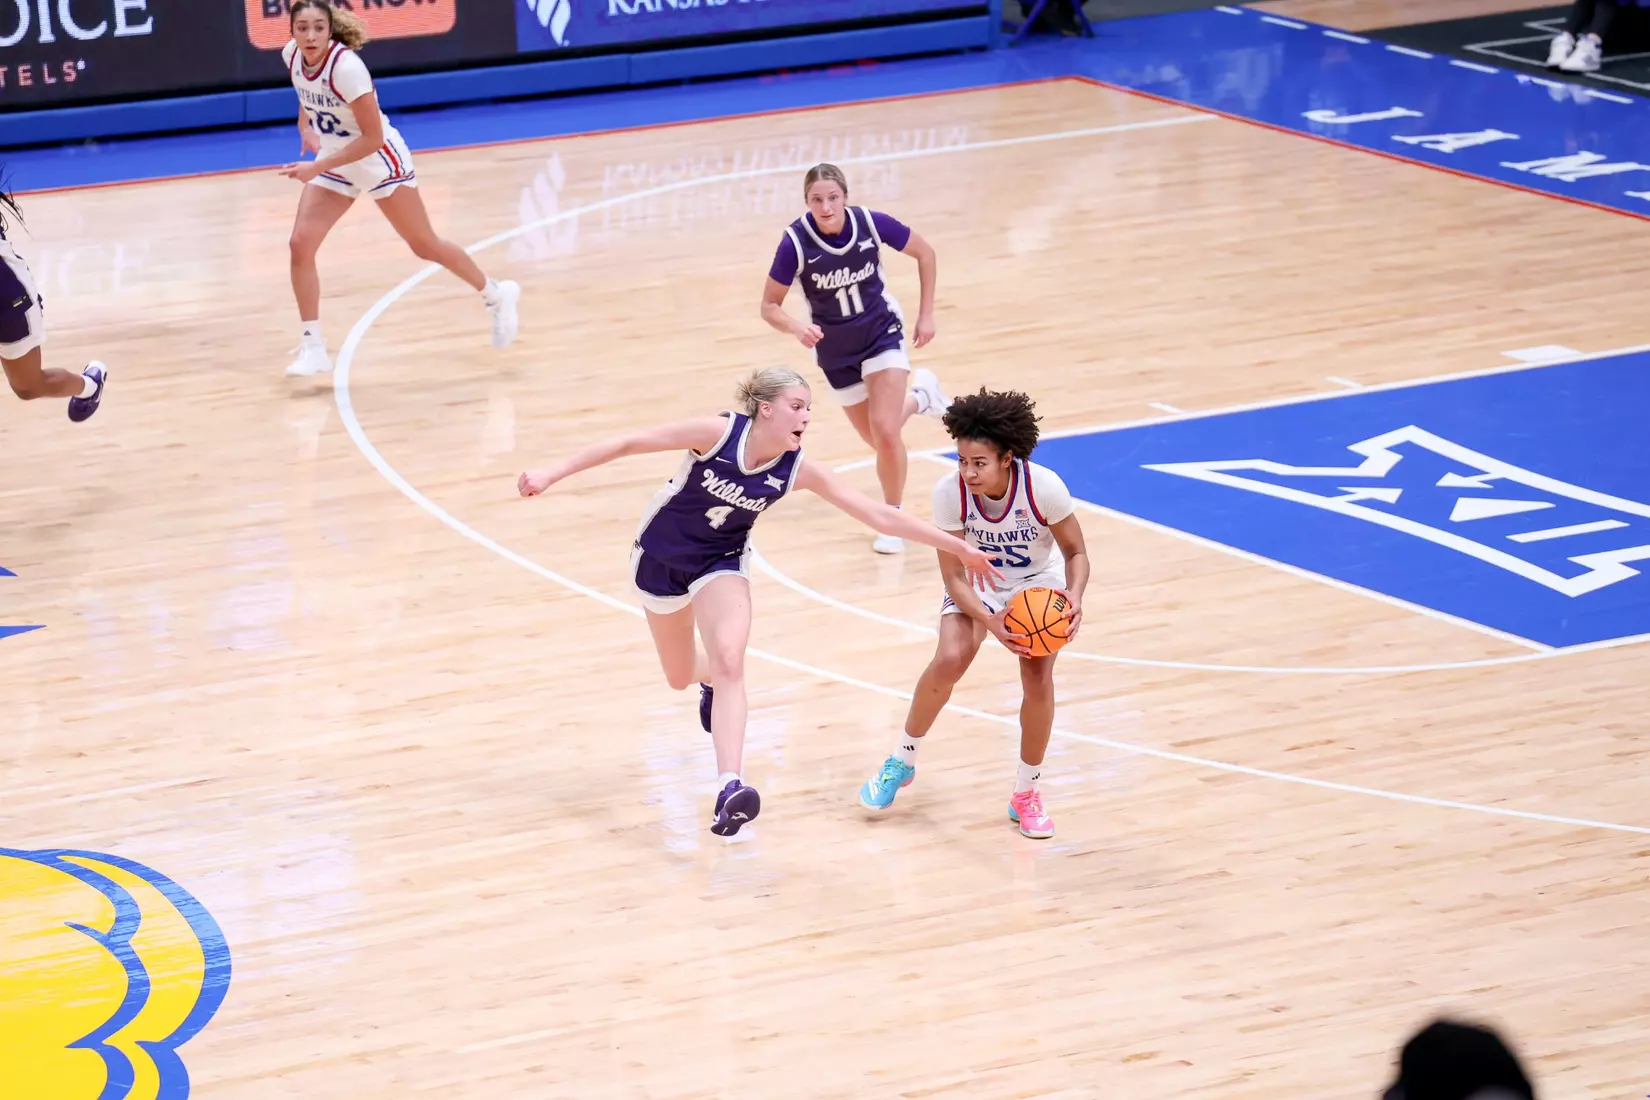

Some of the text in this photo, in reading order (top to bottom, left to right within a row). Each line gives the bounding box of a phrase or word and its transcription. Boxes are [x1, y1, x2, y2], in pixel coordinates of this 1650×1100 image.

[811, 260, 875, 289] Wildcats
[835, 283, 865, 317] 11
[701, 468, 767, 512] Wildcats
[704, 505, 735, 530] 4
[976, 540, 1032, 567] 25
